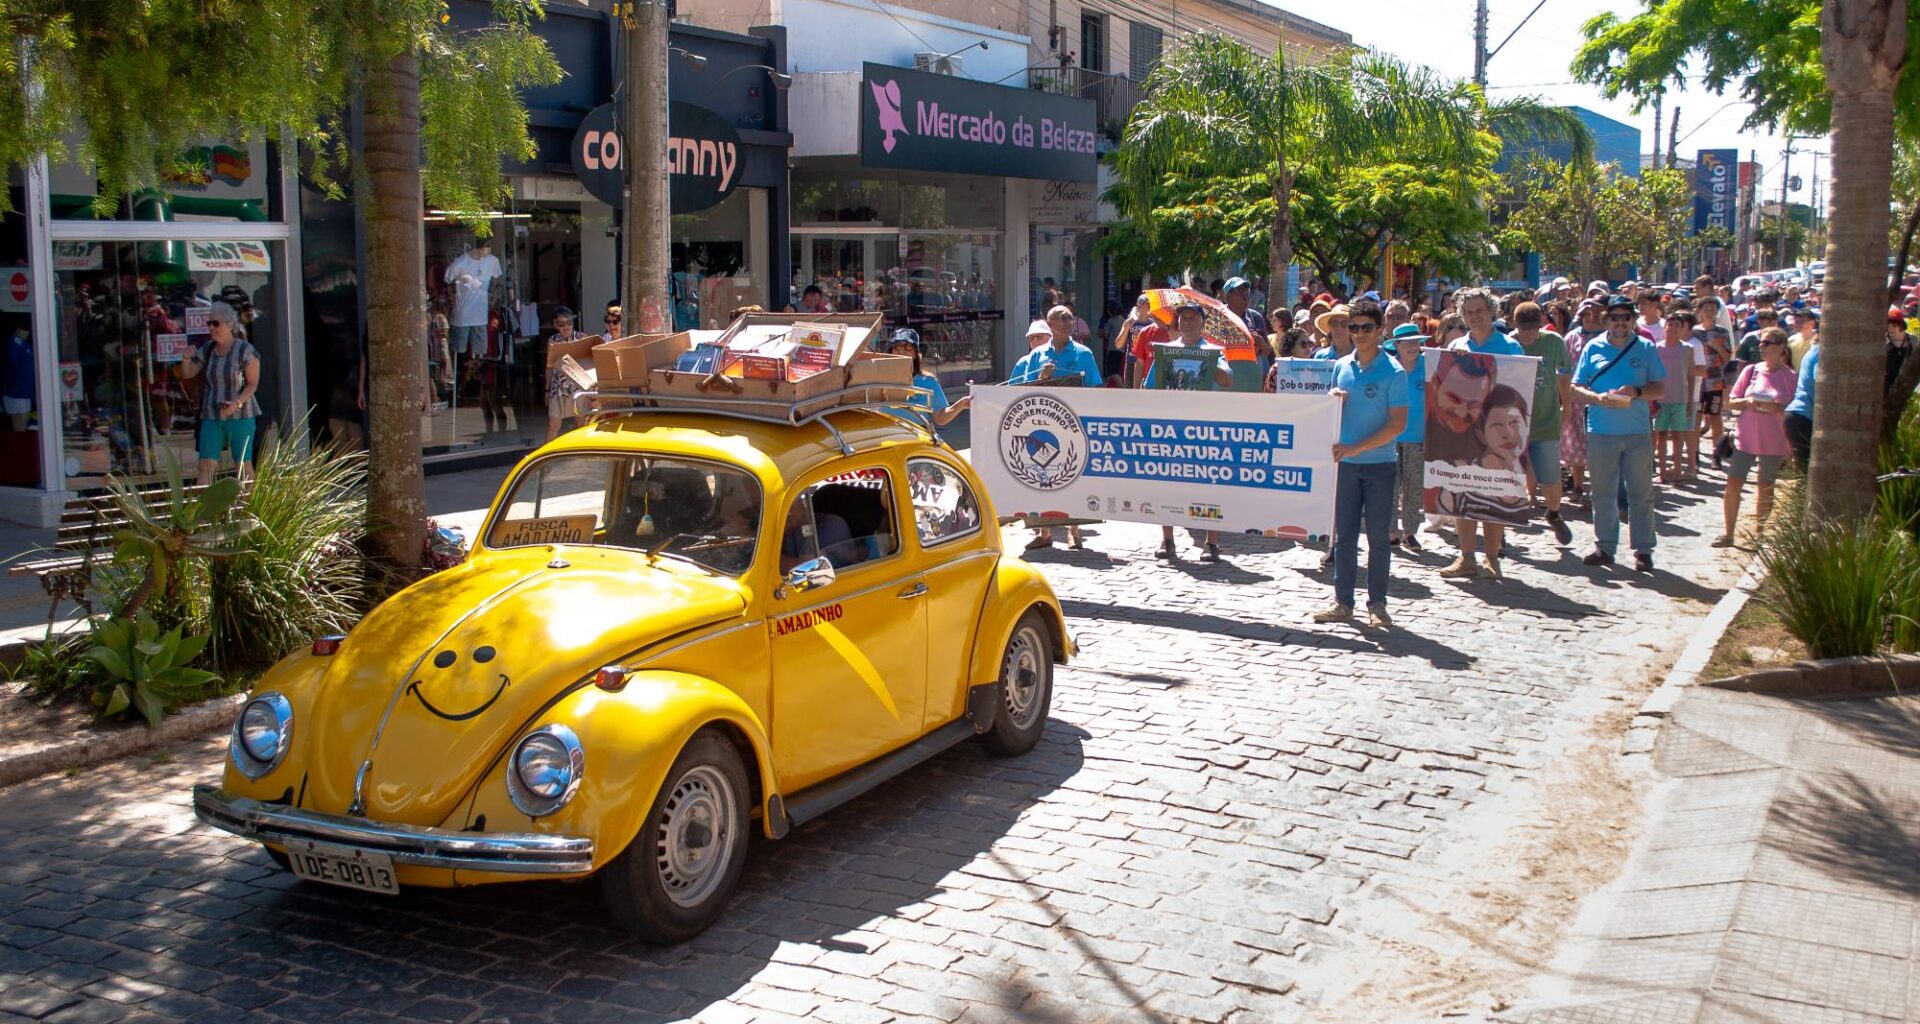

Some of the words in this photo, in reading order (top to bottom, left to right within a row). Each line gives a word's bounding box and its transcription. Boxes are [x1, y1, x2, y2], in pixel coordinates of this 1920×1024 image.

[917, 100, 1006, 145] Mercado
[1012, 115, 1034, 148] da
[1041, 118, 1095, 154] Beleza
[583, 130, 736, 192] coanny
[1707, 165, 1726, 228] Elevato
[1280, 379, 1296, 390] Sob
[1304, 381, 1325, 391] signo
[1003, 403, 1023, 431] CENTRO
[1024, 398, 1037, 407] DE
[1039, 398, 1080, 434] ESCRITORES
[1013, 407, 1070, 430] LOURENCIANOS
[1087, 421, 1144, 438] FESTA
[1150, 423, 1177, 439] DA
[1184, 425, 1271, 444] CULTURA
[1277, 429, 1290, 445] E
[1089, 439, 1116, 454] DA
[1121, 441, 1234, 462] LITERATURA
[1240, 447, 1269, 464] EM
[1090, 454, 1129, 474] SÃO
[1134, 460, 1233, 484] LOURENÇO
[1239, 467, 1267, 483] DO
[1272, 469, 1308, 487] SUL
[1429, 467, 1436, 475] O
[1436, 469, 1460, 480] tempo
[1461, 472, 1472, 480] de
[503, 529, 582, 547] AMADINHO
[520, 520, 568, 531] FUSCA
[776, 604, 843, 636] AMADINHO
